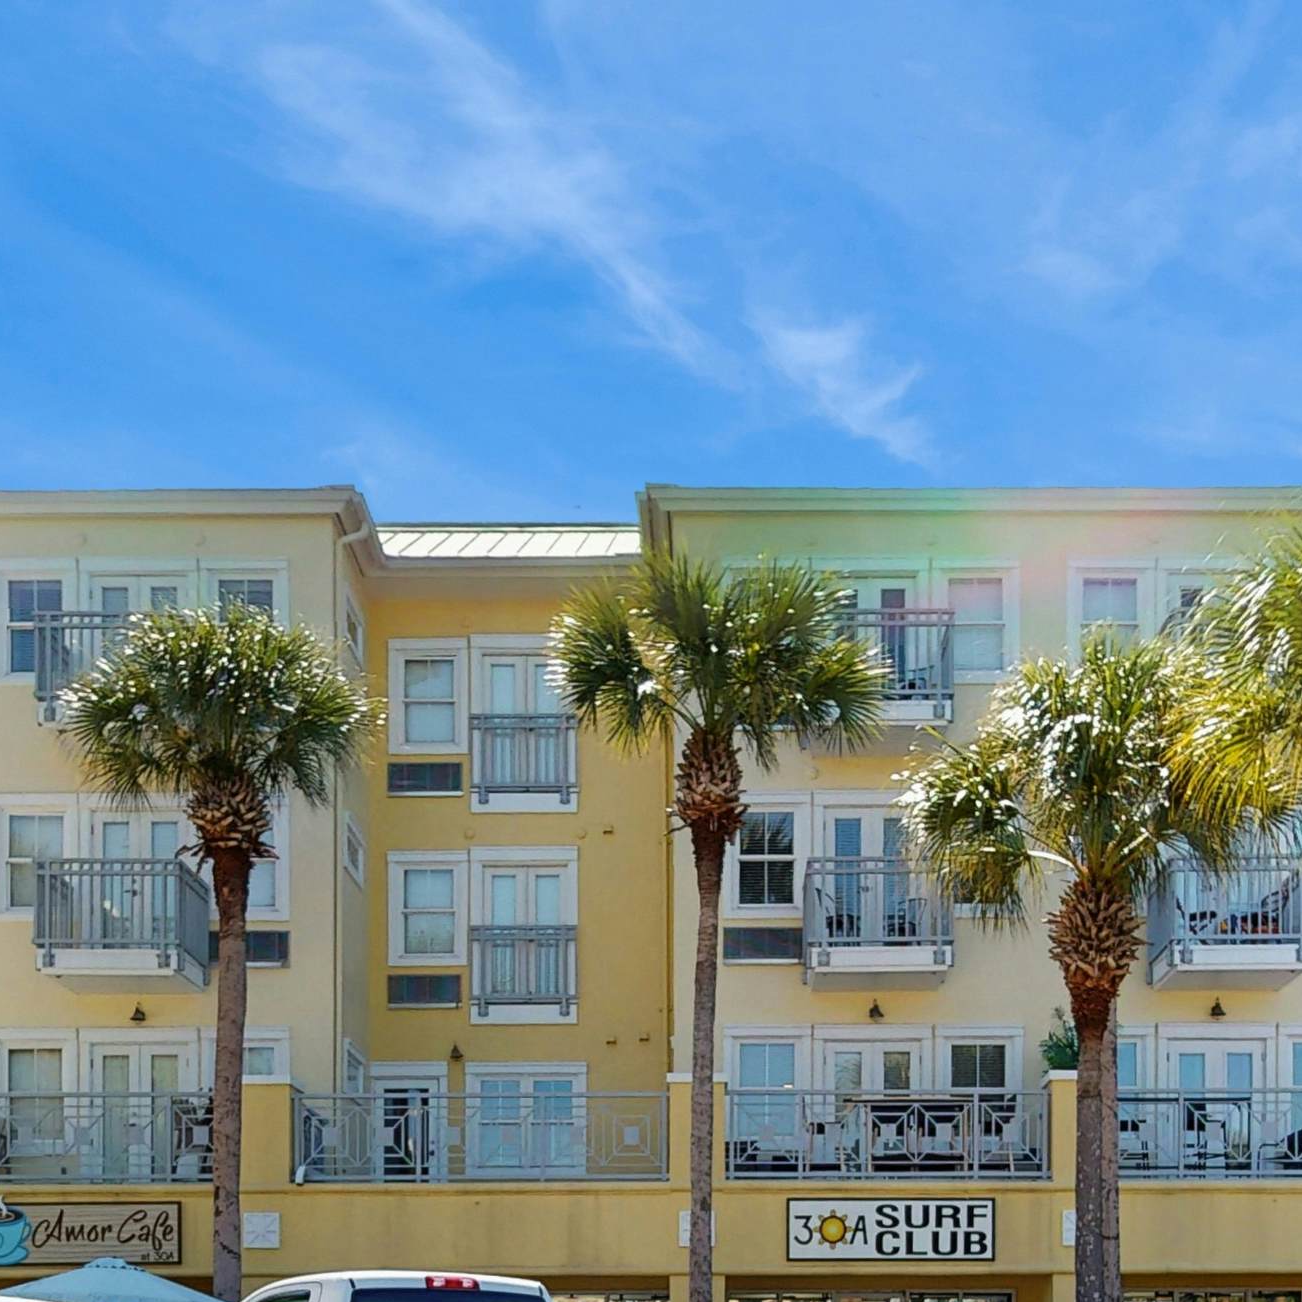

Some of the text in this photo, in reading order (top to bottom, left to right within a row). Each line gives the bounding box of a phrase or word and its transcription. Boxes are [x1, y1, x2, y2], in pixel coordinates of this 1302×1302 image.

[875, 1204, 989, 1229] SURF
[32, 1208, 174, 1252] Amor Cafe
[875, 1231, 988, 1256] CLUB
